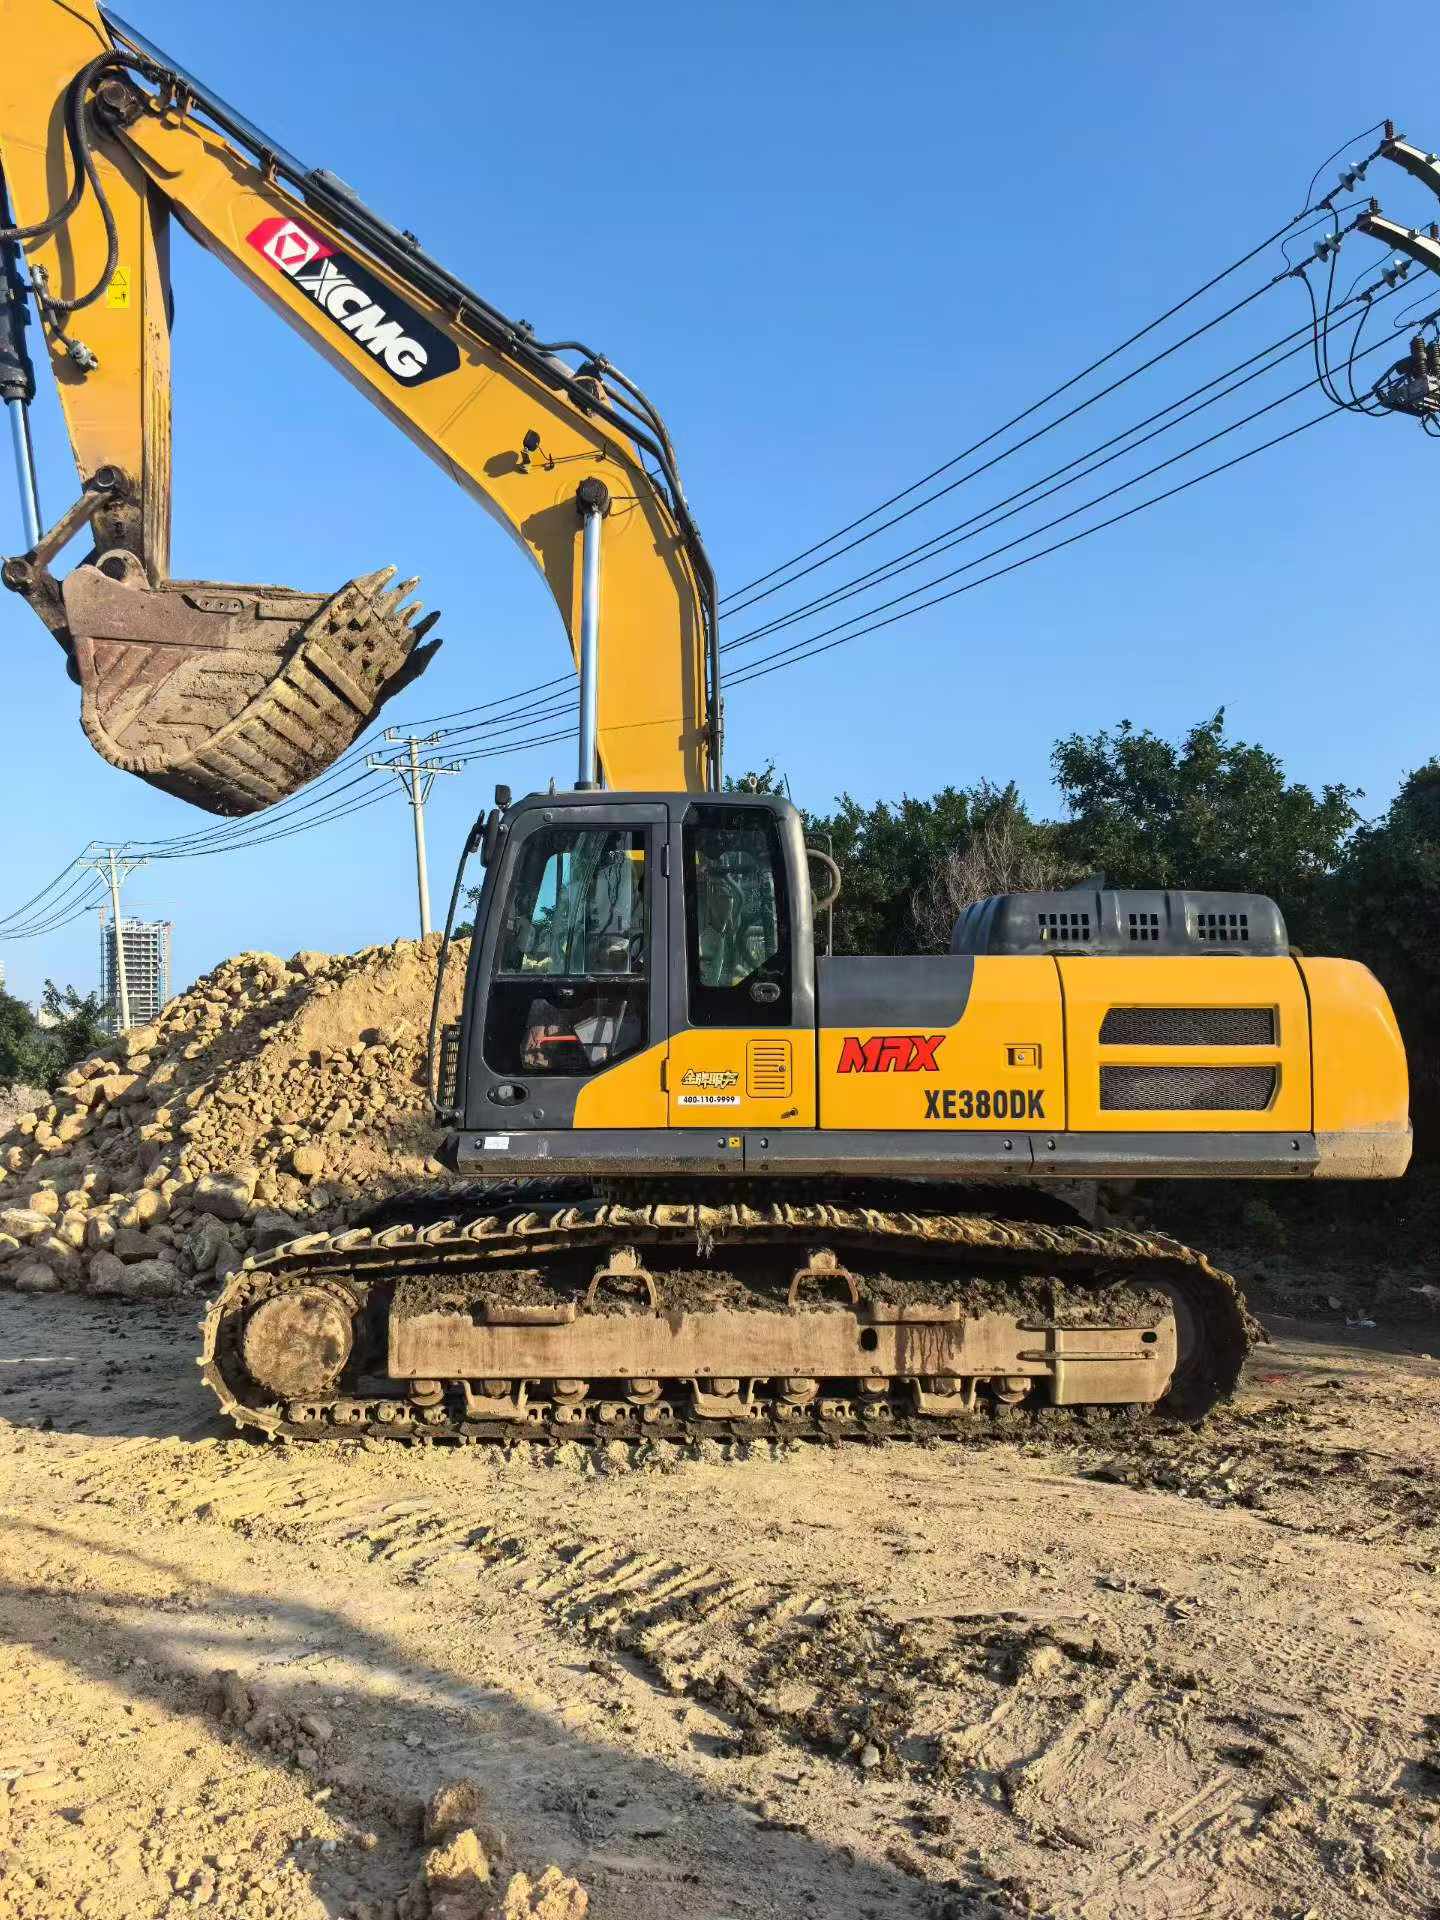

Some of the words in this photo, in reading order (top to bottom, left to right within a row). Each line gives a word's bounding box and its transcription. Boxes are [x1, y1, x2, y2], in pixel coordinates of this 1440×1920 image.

[293, 258, 428, 378] XCMG
[836, 1035, 946, 1074] MAX
[683, 1095, 736, 1104] 400-110-9999
[924, 1089, 1045, 1119] XE380DK
